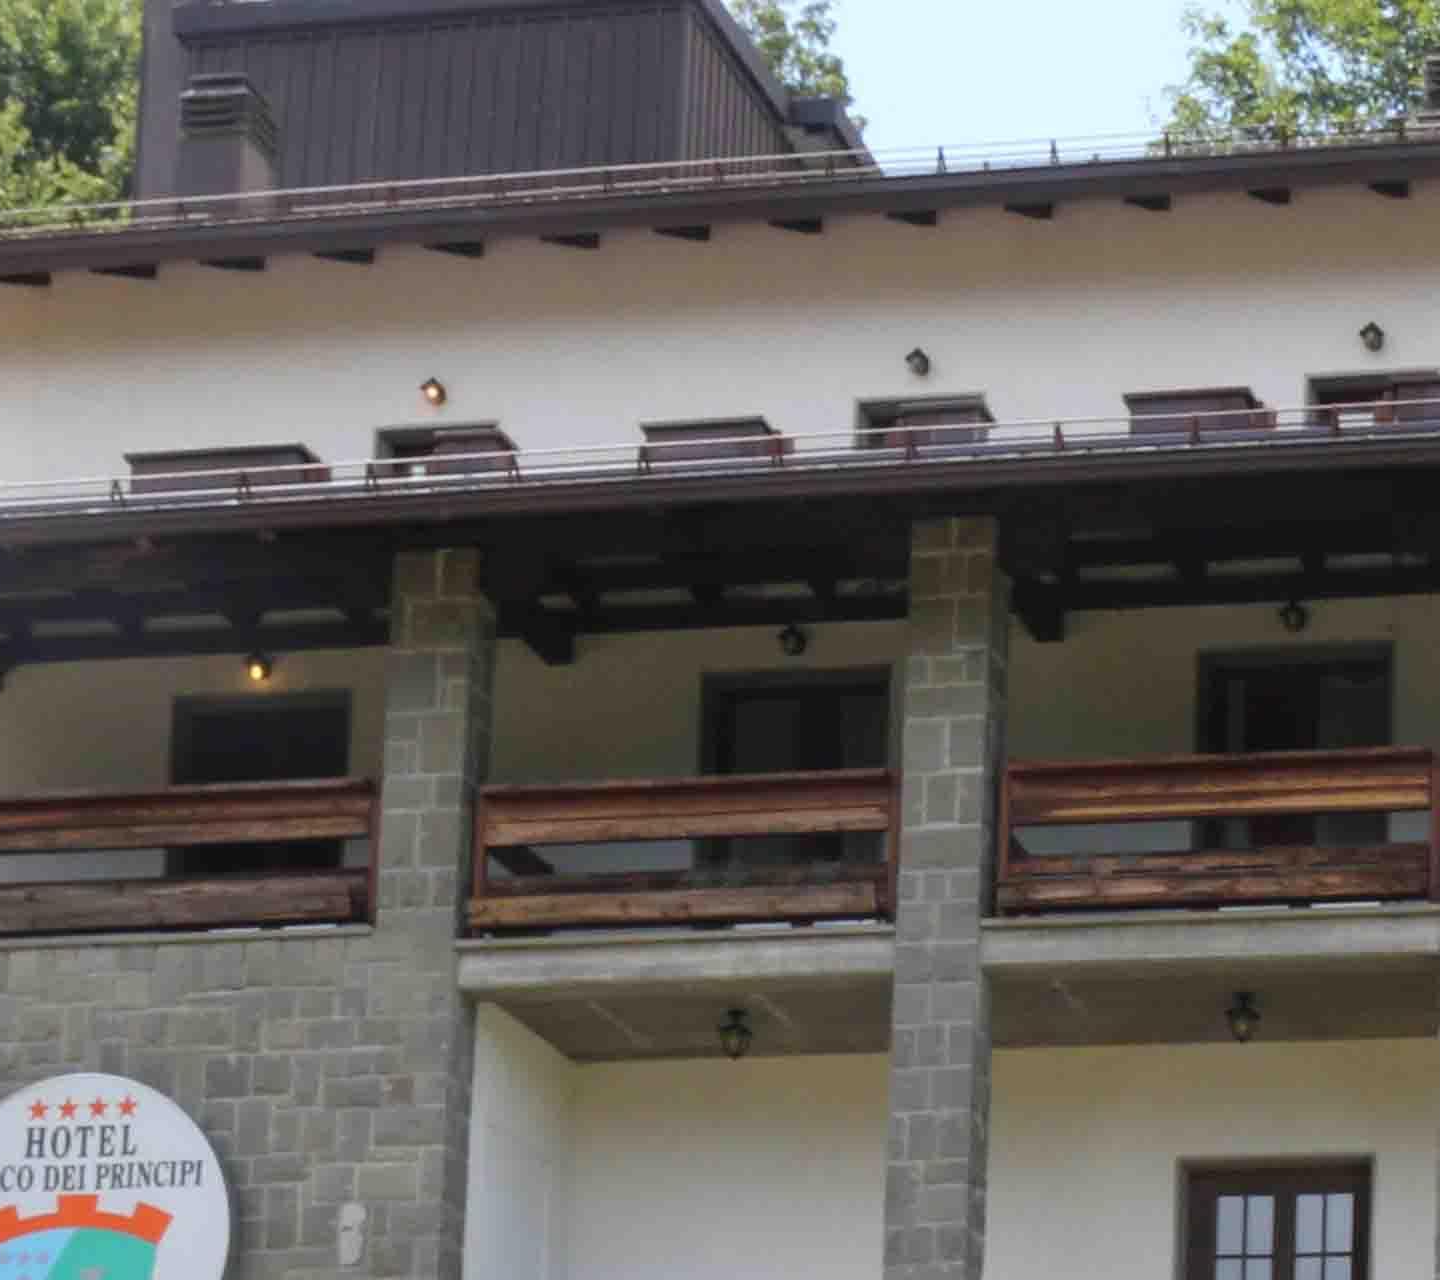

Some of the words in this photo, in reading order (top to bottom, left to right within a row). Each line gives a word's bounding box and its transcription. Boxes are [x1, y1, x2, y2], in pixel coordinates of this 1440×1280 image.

[24, 1124, 139, 1159] HOTEL
[42, 1164, 87, 1192] DEI
[95, 1160, 204, 1190] PRINCIPI
